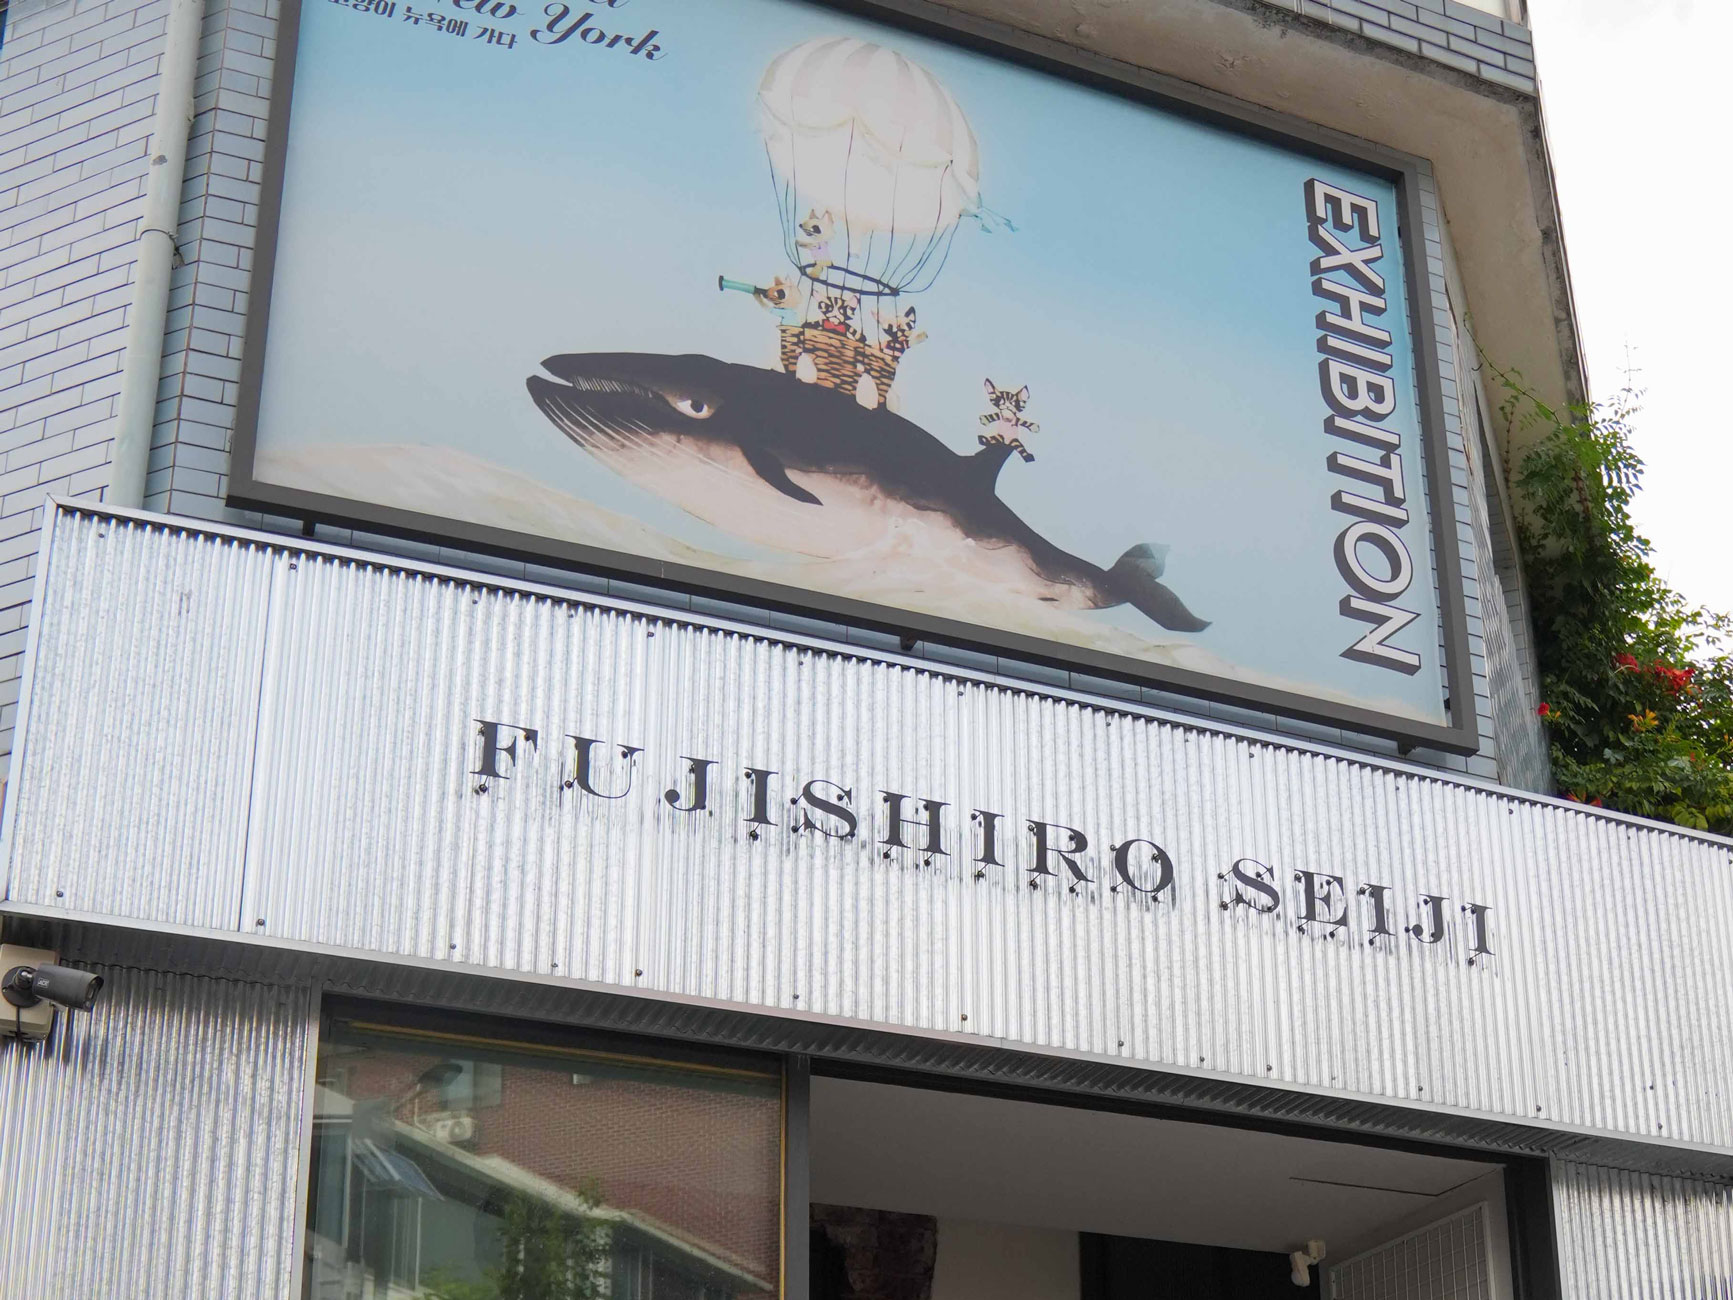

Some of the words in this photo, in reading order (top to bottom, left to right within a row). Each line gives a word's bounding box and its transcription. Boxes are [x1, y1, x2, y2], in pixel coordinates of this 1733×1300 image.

[403, 6, 469, 37] 뉴욕에
[473, 26, 518, 49] 가다
[446, 0, 525, 19] ew
[530, 3, 668, 60] York
[1304, 178, 1422, 676] EXHIBITION
[470, 719, 1174, 893] FUJISHIRO
[1232, 858, 1496, 956] SEIJI
